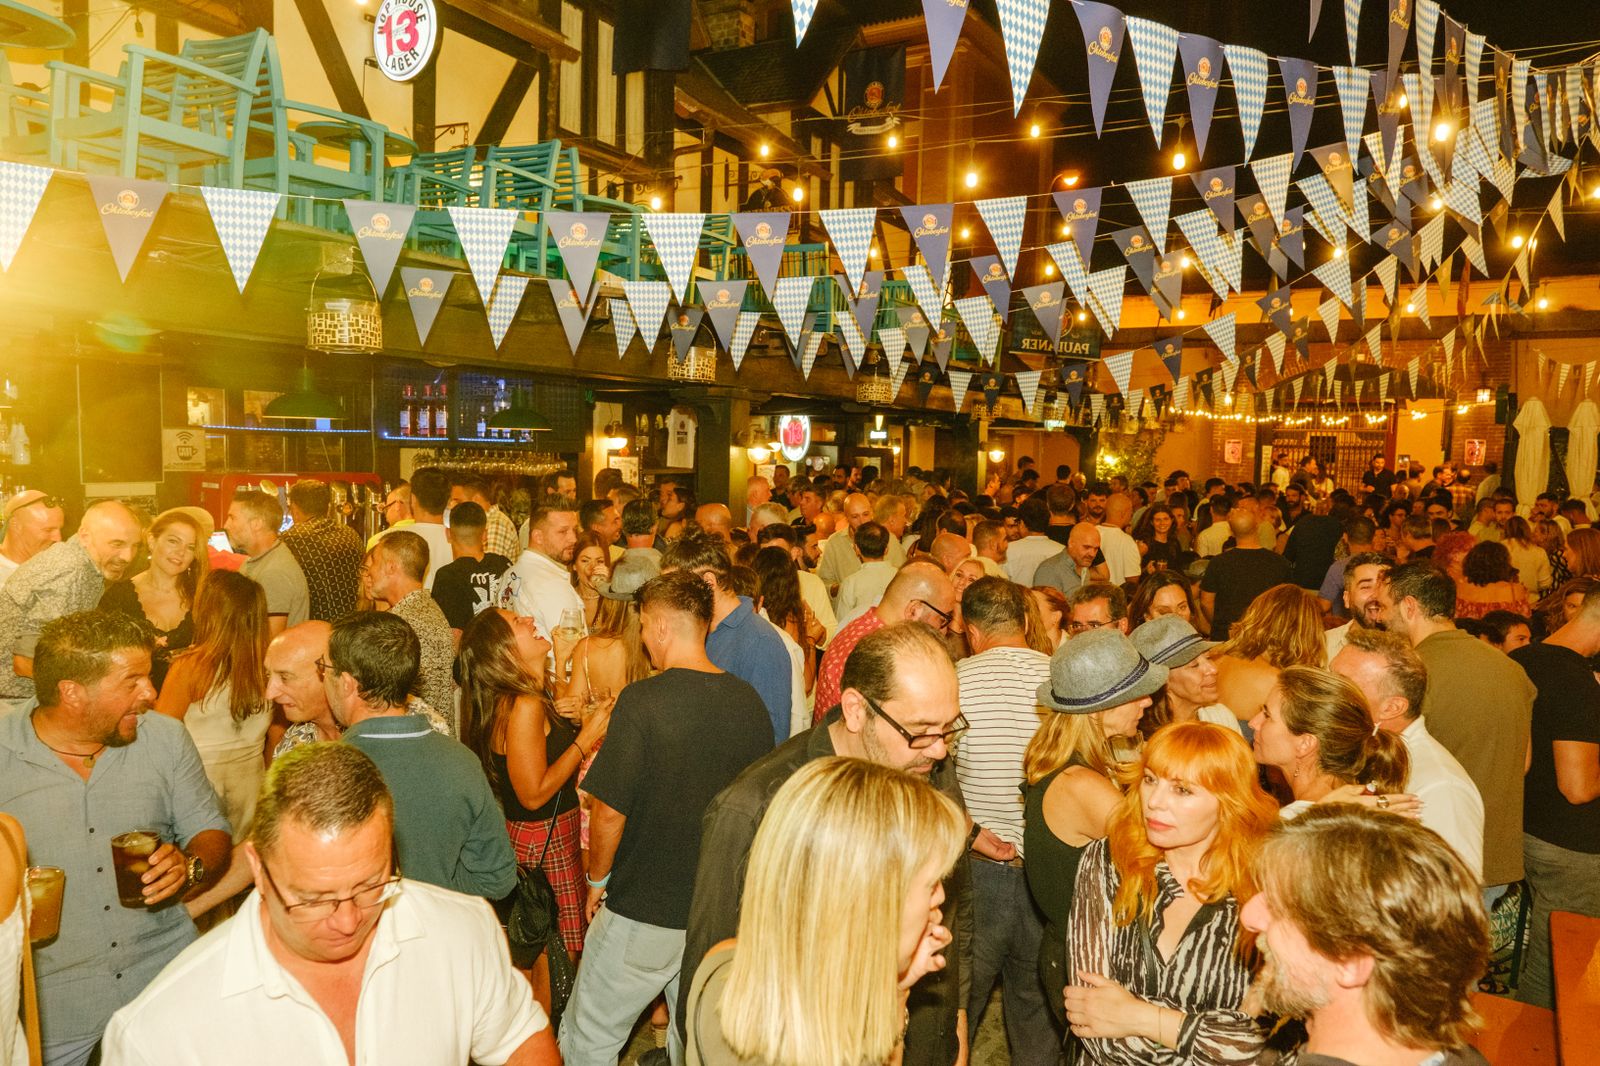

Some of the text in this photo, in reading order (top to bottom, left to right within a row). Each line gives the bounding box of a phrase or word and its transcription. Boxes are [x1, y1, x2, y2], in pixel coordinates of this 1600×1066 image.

[377, 2, 391, 34] HOP
[383, 10, 419, 56] 13
[385, 47, 419, 71] LAGER
[100, 202, 154, 218] Oktoberfest
[357, 226, 404, 240] Oktoberfest
[559, 236, 600, 249] Oktoberfest
[745, 236, 784, 248] Oktoberfest
[787, 422, 804, 445] 13
